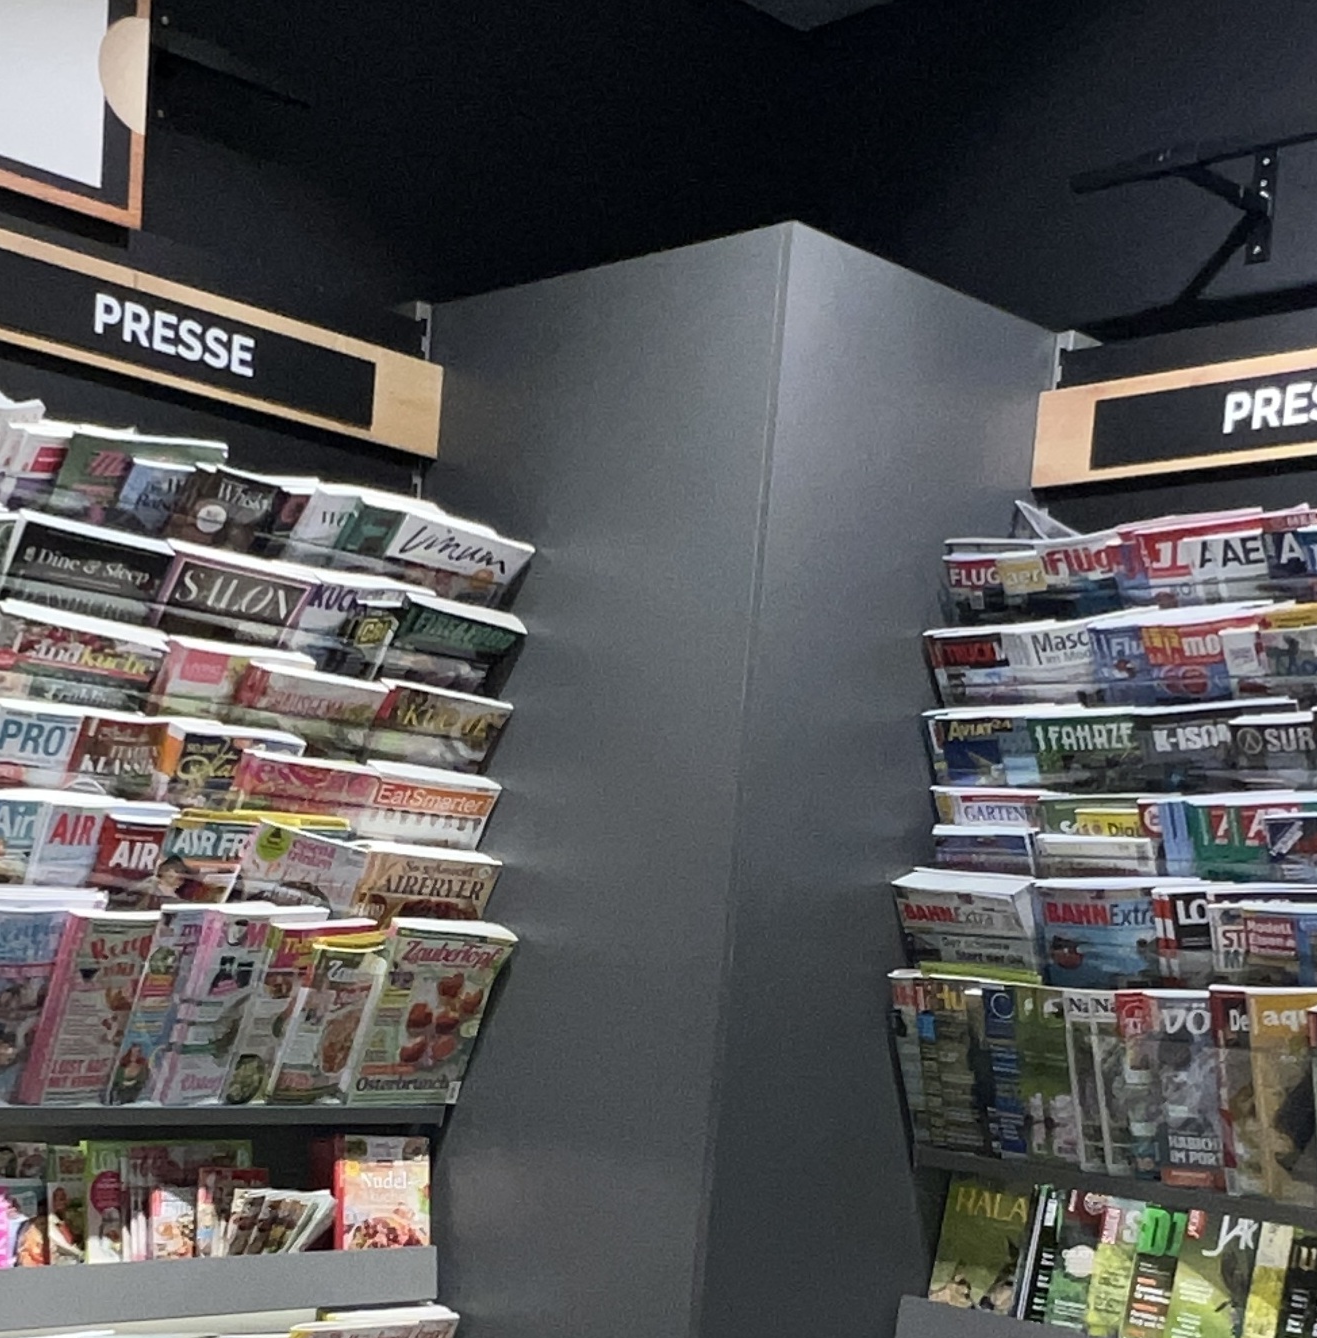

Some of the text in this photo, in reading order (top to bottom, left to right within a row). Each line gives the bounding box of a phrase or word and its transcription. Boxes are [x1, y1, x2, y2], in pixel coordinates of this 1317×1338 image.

[93, 294, 256, 378] PRESSE
[949, 569, 999, 587] FLUG
[49, 812, 96, 847] AIR
[110, 840, 159, 867] AIR
[173, 829, 214, 858] AIR
[902, 900, 955, 924] BAHN
[1045, 902, 1110, 925] BAHN
[360, 1170, 418, 1193] Nudel-
